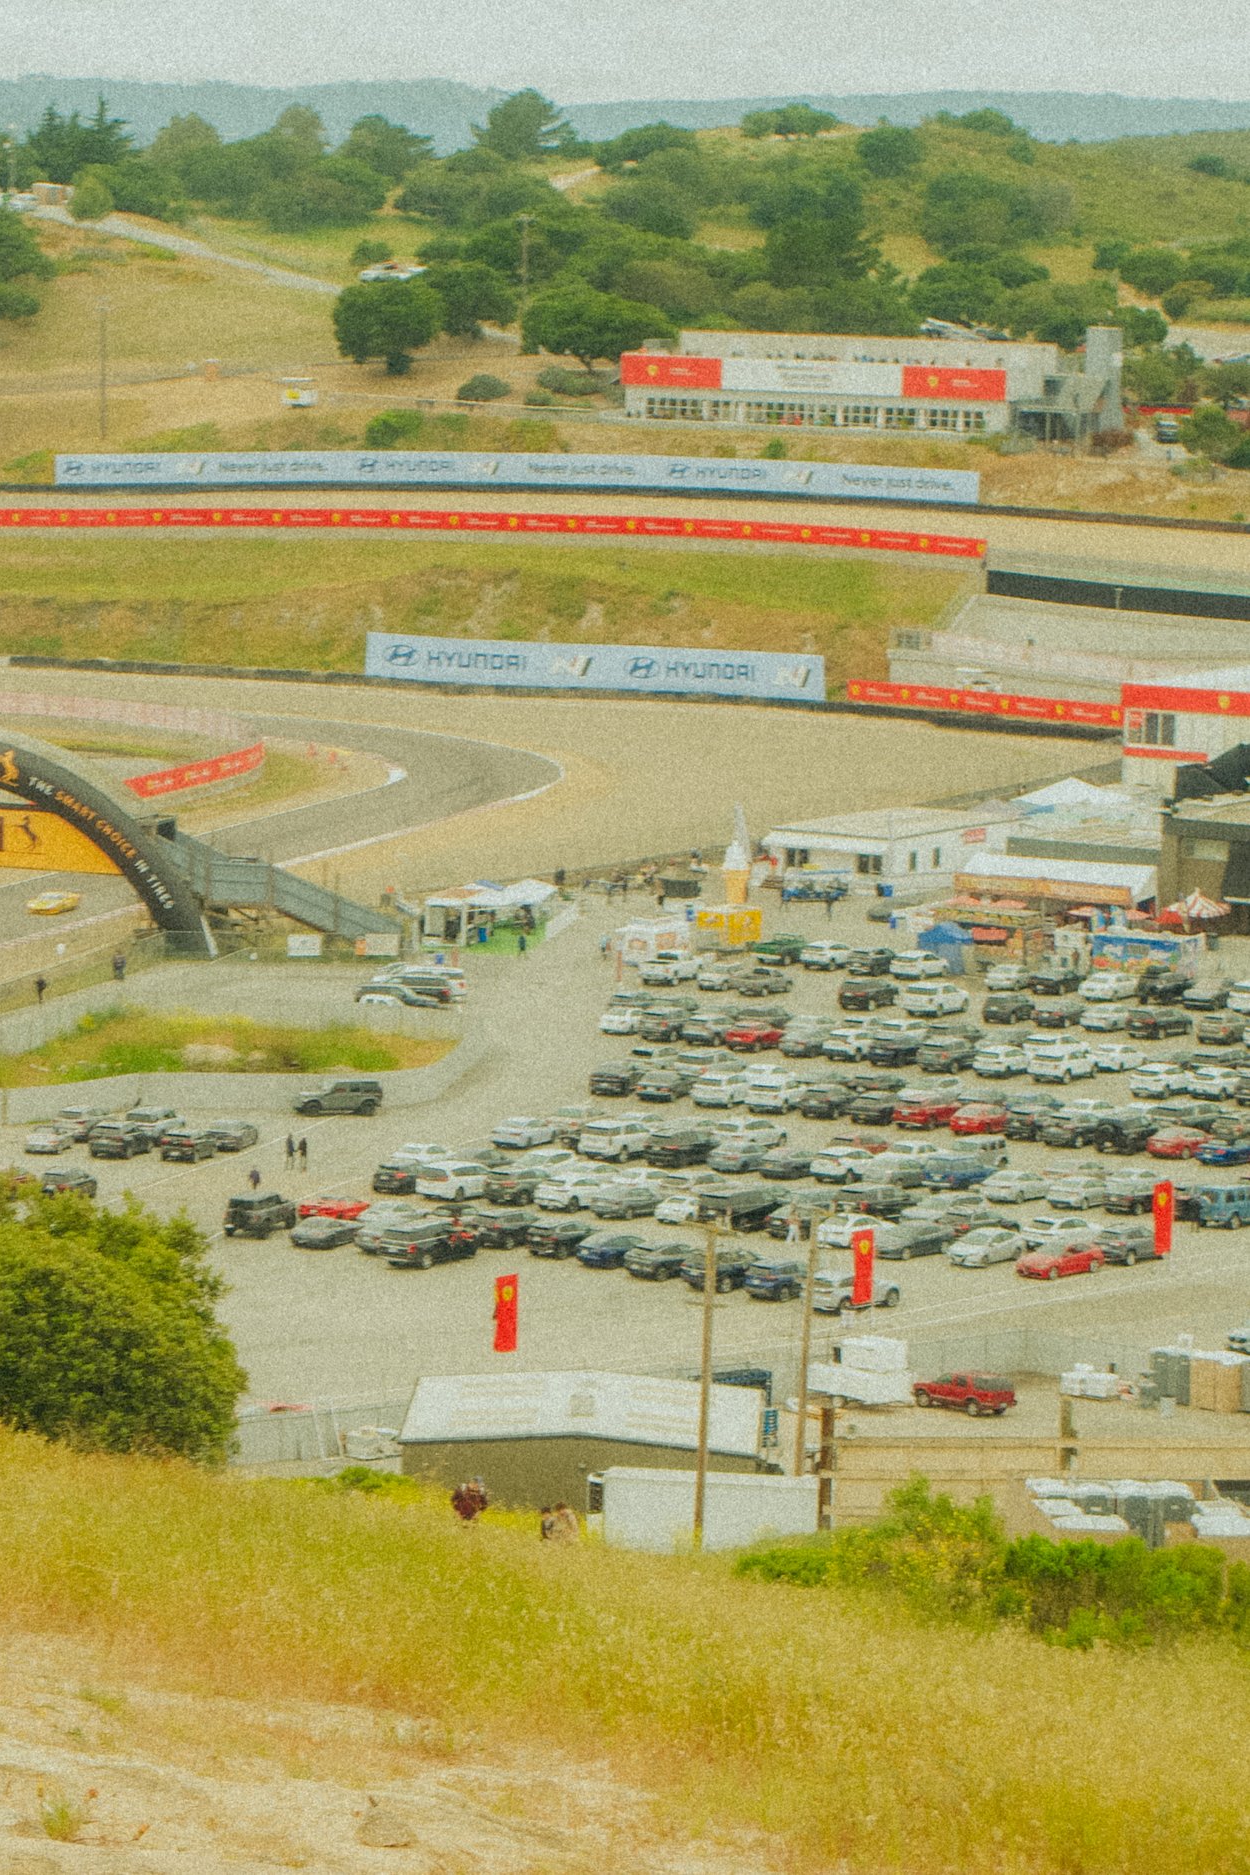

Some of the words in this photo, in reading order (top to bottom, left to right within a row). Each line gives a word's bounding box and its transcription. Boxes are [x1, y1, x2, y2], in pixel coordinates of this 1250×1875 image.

[426, 649, 527, 672] HYUNDAI
[664, 659, 756, 682] HYUNDAI
[54, 790, 98, 821] SMART
[95, 819, 138, 859] CHOICE
[147, 873, 175, 910] TIRES
